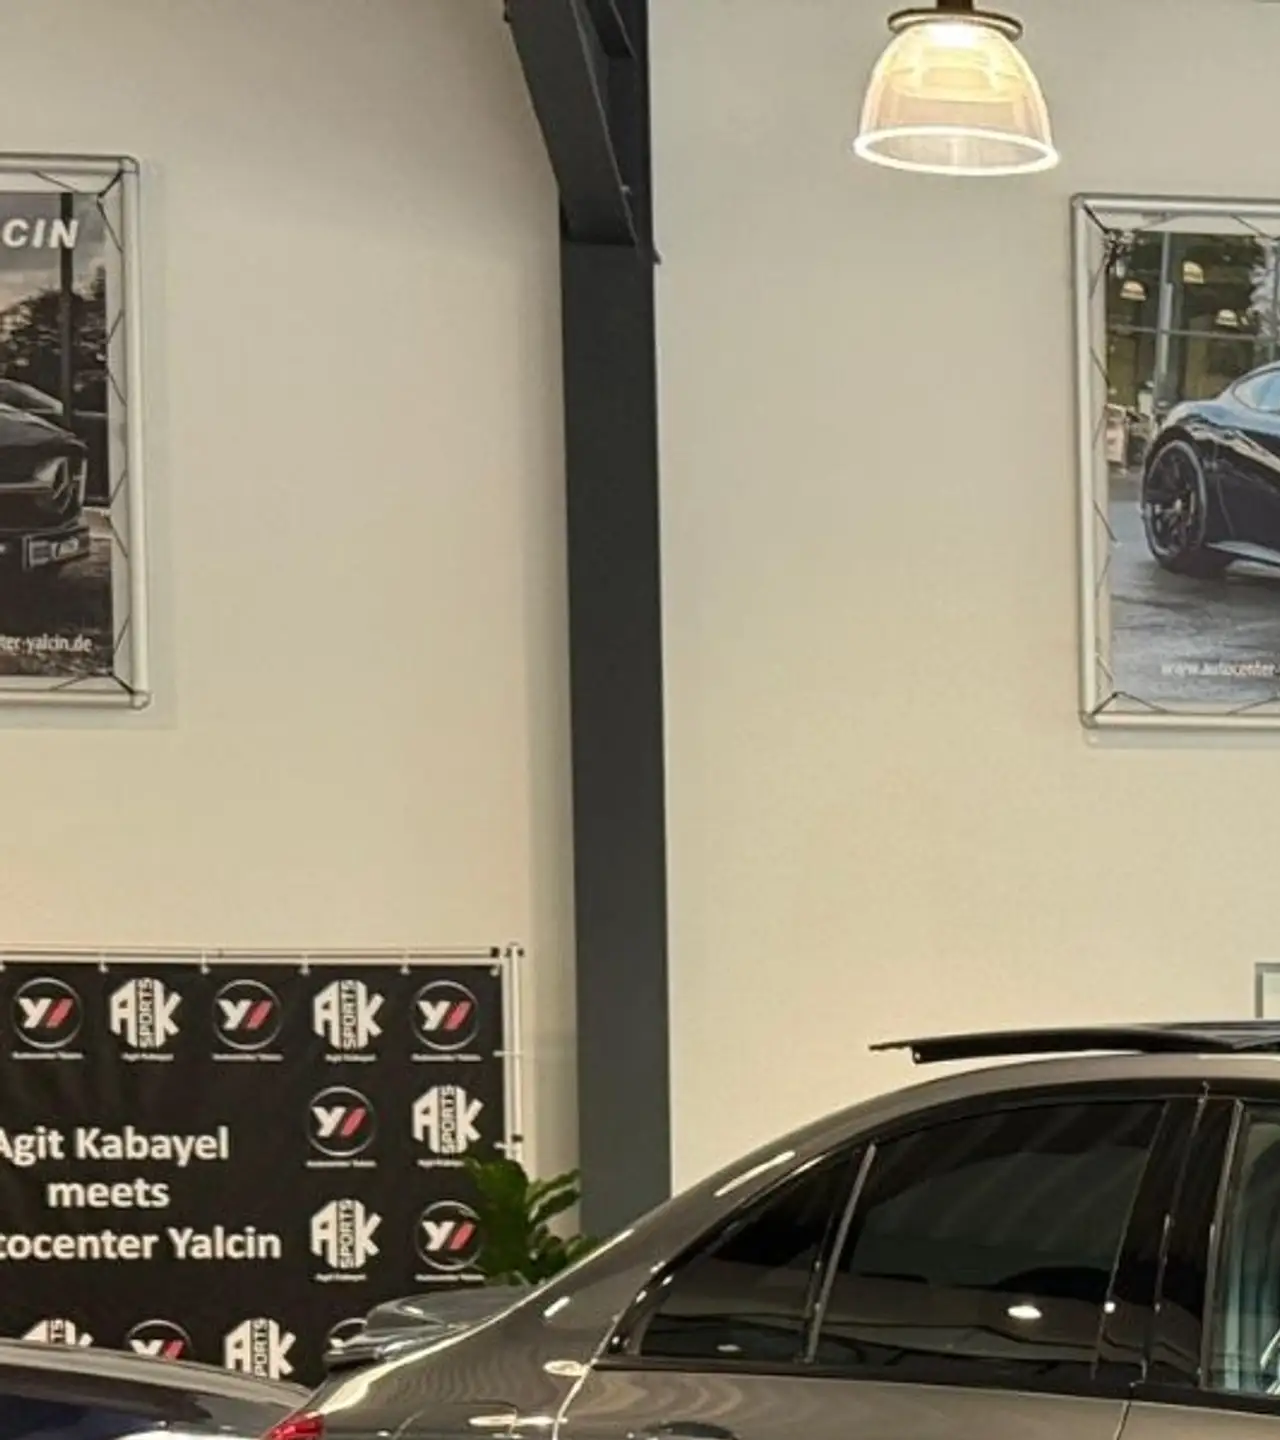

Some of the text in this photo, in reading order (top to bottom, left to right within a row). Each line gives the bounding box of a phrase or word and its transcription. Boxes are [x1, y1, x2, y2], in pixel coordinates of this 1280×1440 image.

[2, 218, 79, 249] CIN
[75, 1124, 230, 1167] Kabayel
[47, 1177, 170, 1208] meets
[167, 1225, 282, 1260] Yalcin
[254, 1319, 270, 1379] PORTS
